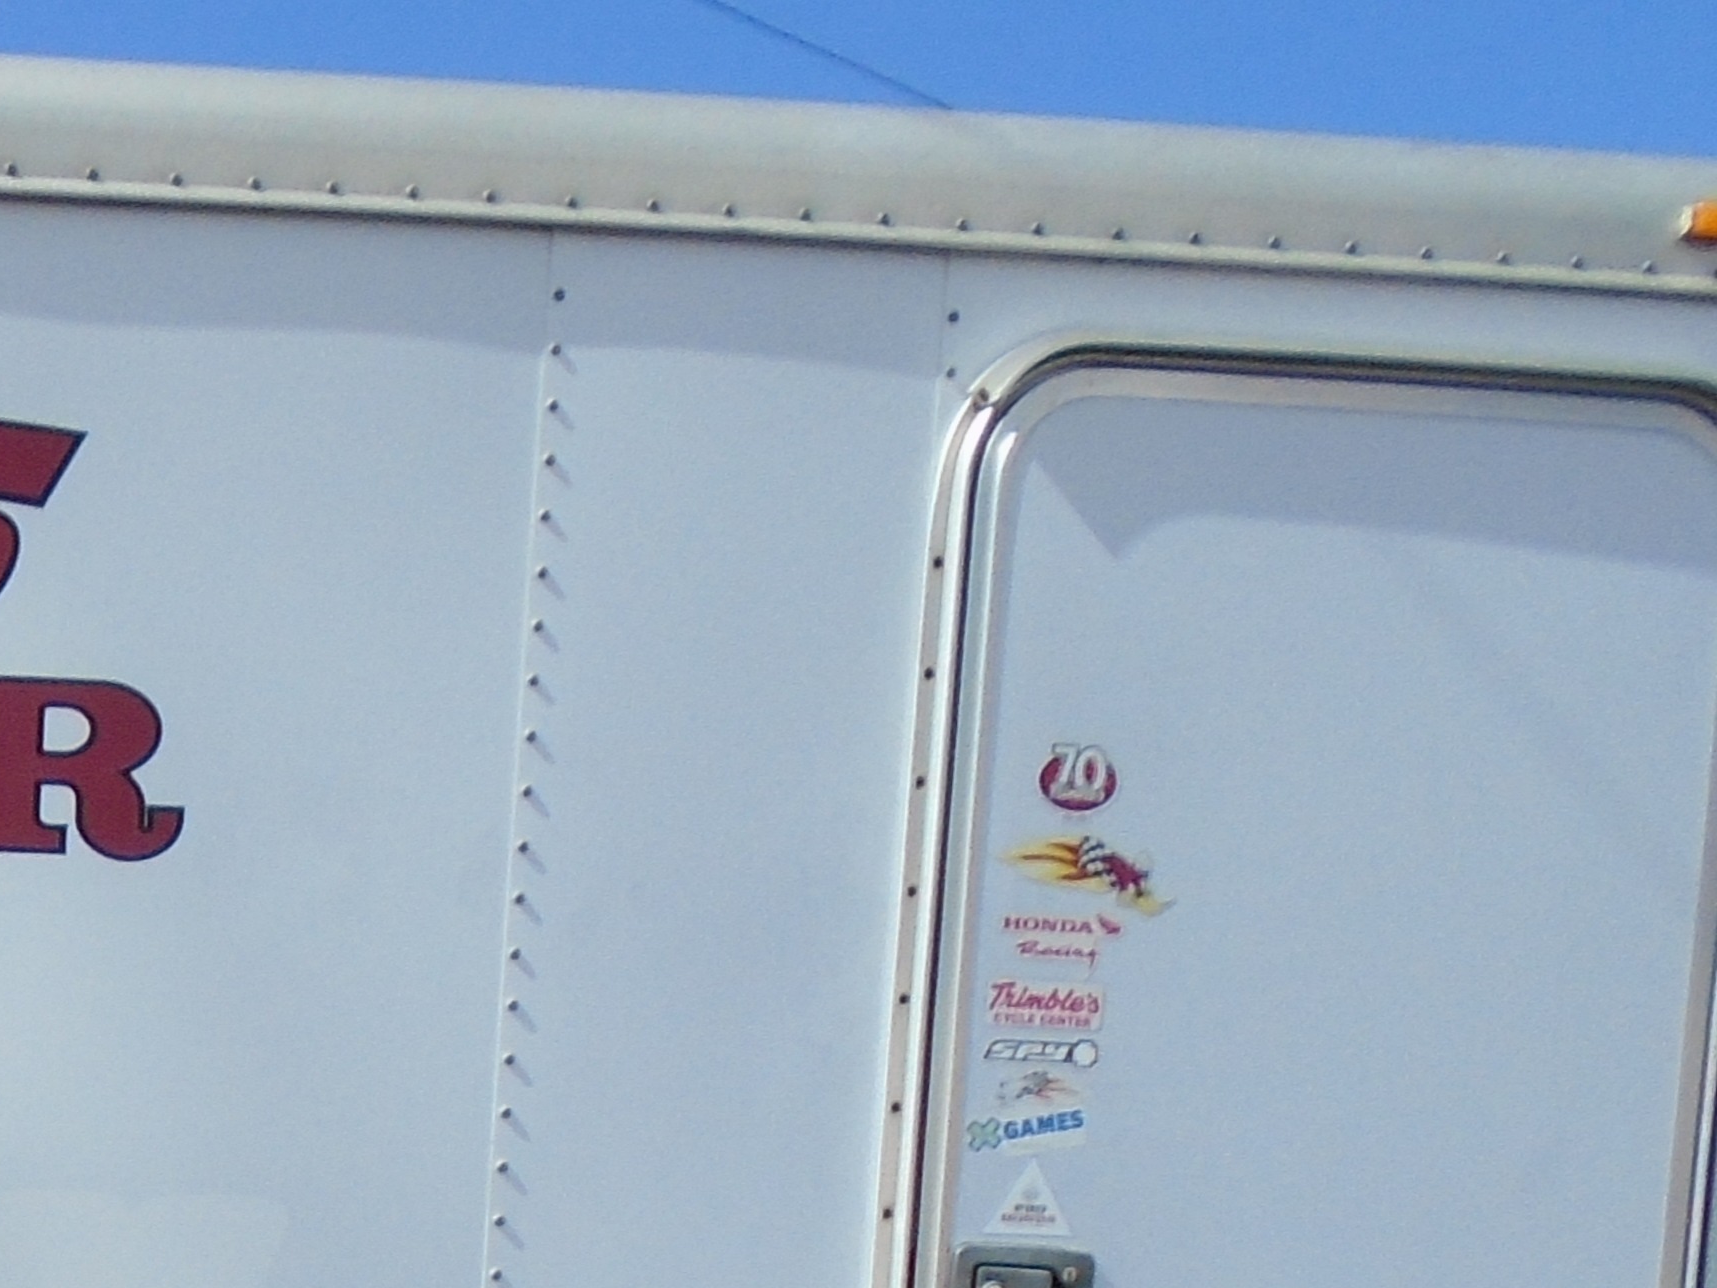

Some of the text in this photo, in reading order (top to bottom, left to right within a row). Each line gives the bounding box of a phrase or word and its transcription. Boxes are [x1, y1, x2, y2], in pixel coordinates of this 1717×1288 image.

[1051, 742, 1107, 789] 70
[1003, 917, 1093, 934] HONDA
[989, 981, 1099, 1014] Trimble's
[1004, 1108, 1085, 1140] GAMES
